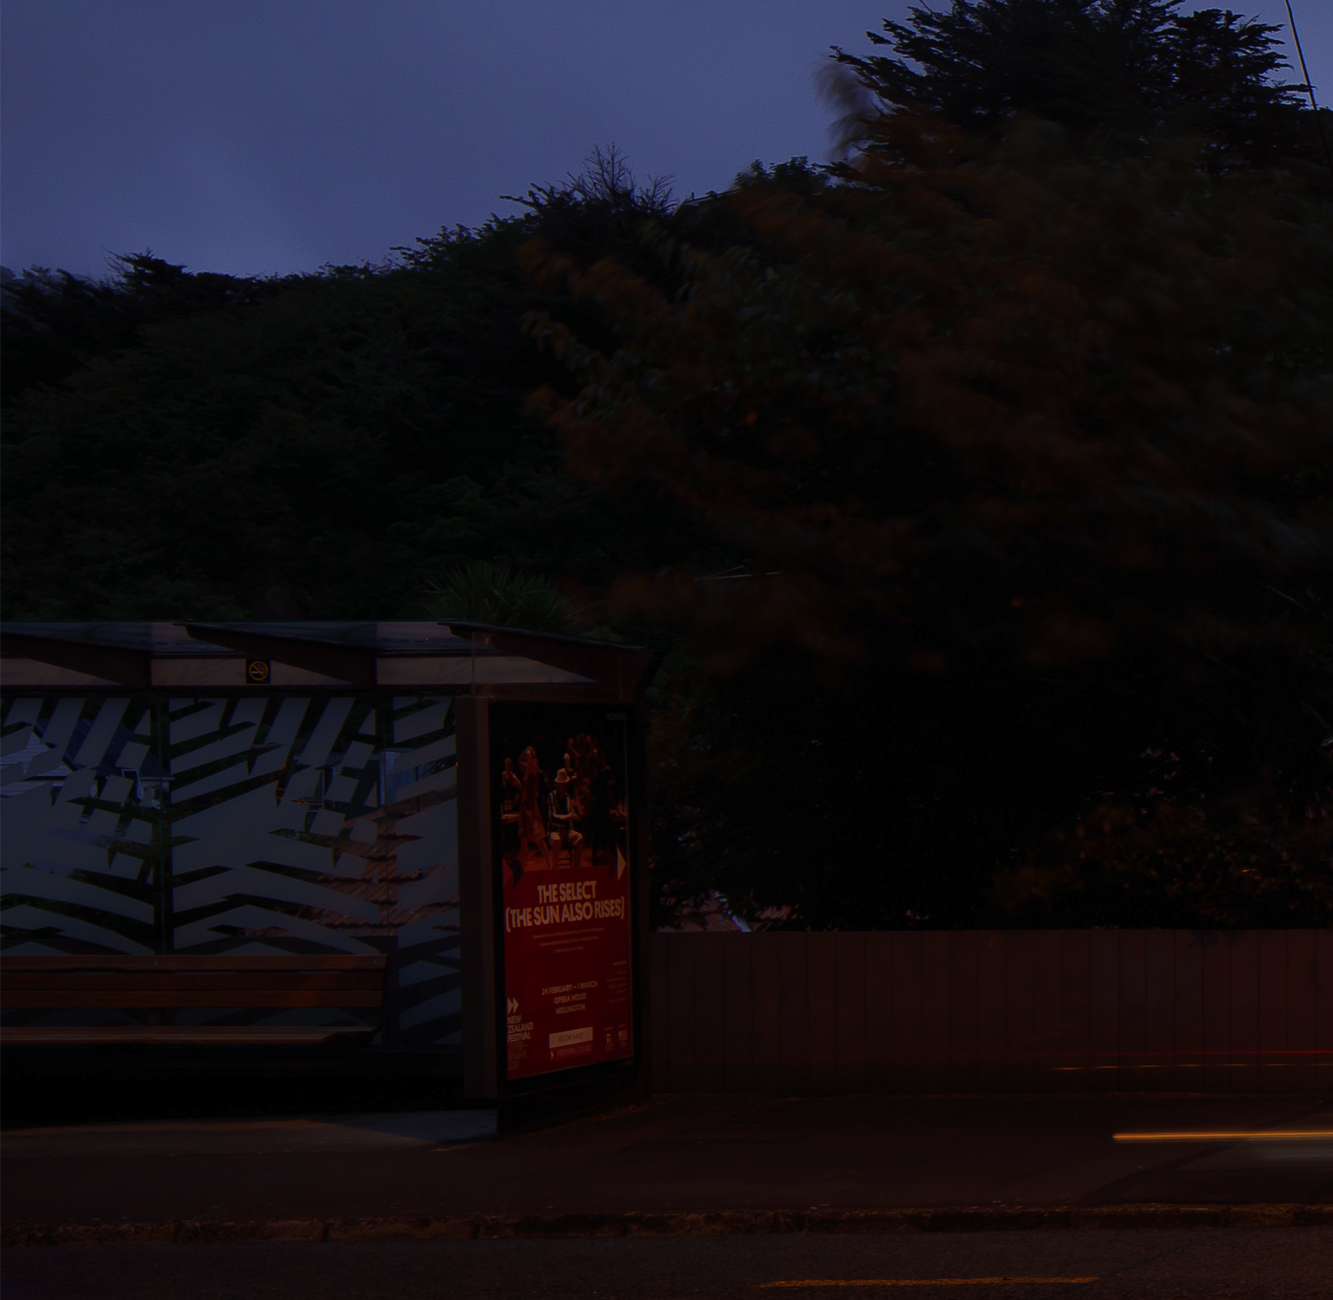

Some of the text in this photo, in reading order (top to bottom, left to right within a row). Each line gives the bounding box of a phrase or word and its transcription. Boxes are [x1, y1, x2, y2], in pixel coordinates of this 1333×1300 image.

[537, 880, 597, 904] THE SELECT
[505, 906, 533, 933] (THE
[533, 904, 560, 926] SUN
[561, 901, 593, 922] ALSO
[594, 895, 625, 920] RISES)
[549, 984, 572, 994] FEBRUARY
[580, 980, 599, 989] MARCH
[554, 995, 571, 1004] OPERA
[507, 1014, 522, 1025] NEW
[507, 1021, 534, 1034] ZEALAND
[507, 1031, 532, 1043] FESTIVAL
